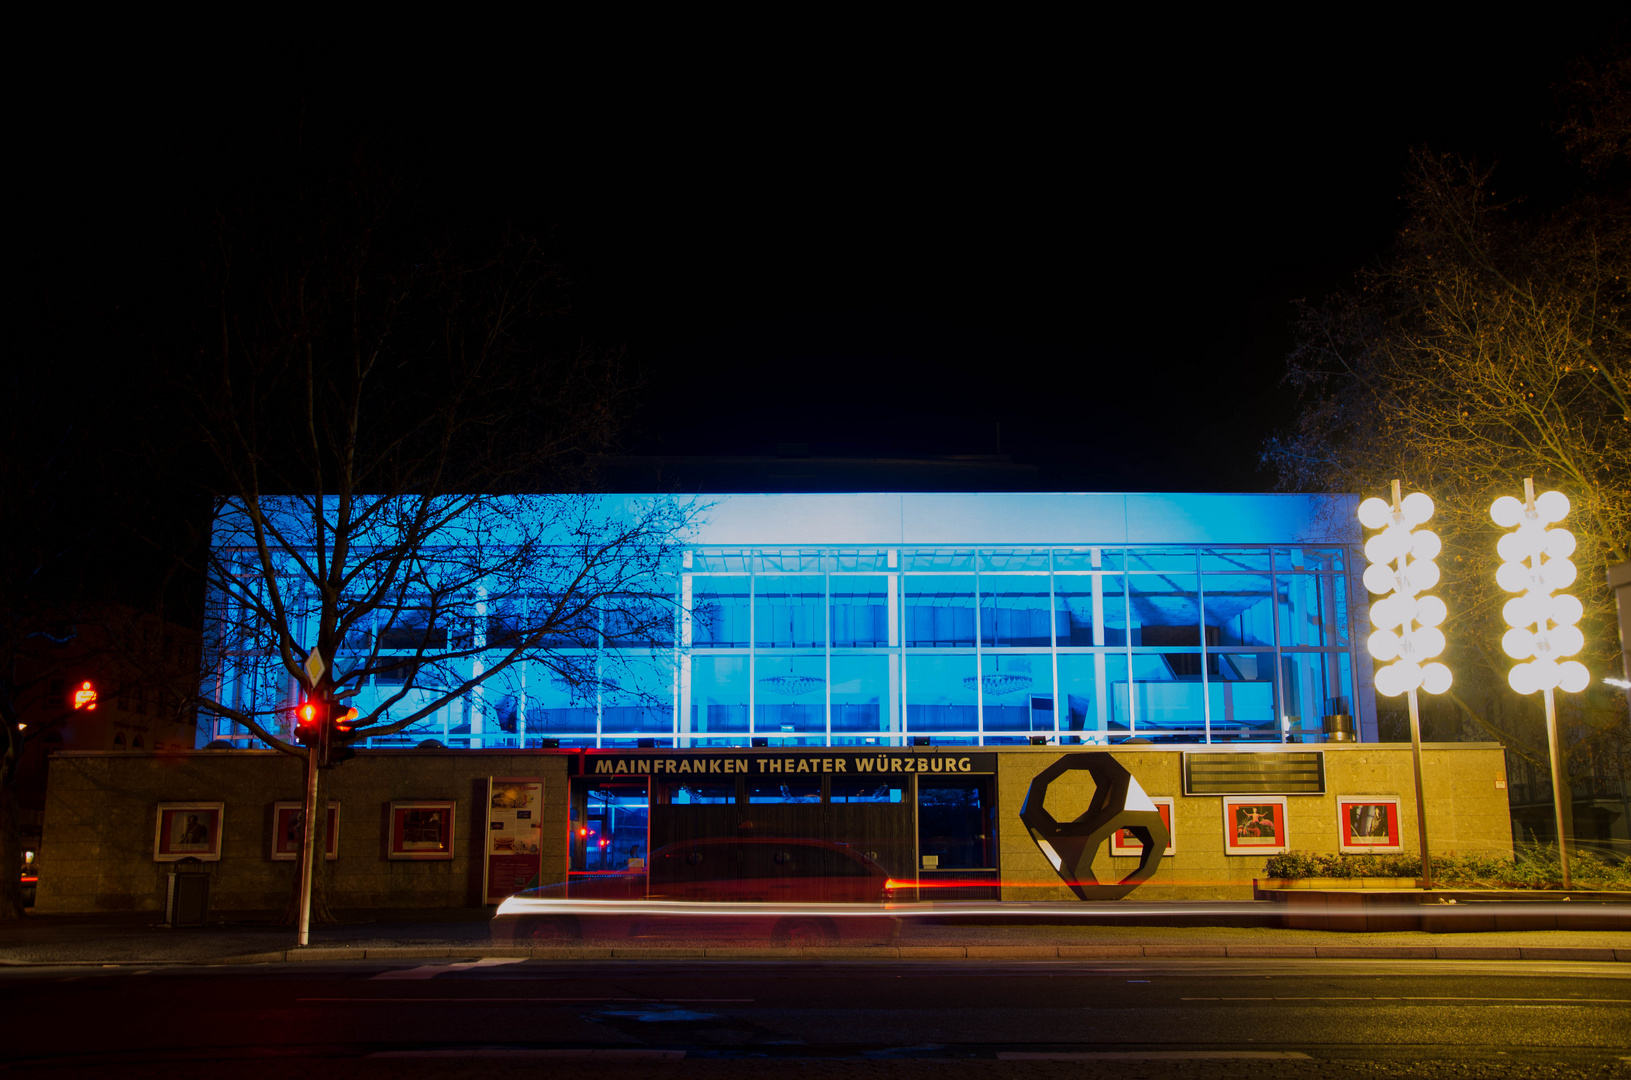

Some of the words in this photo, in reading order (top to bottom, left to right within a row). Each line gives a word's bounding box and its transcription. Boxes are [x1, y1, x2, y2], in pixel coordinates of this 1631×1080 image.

[595, 759, 749, 774] MAINFRANKEN
[757, 758, 847, 773] THEATER
[855, 755, 972, 772] WÜRZBURG
